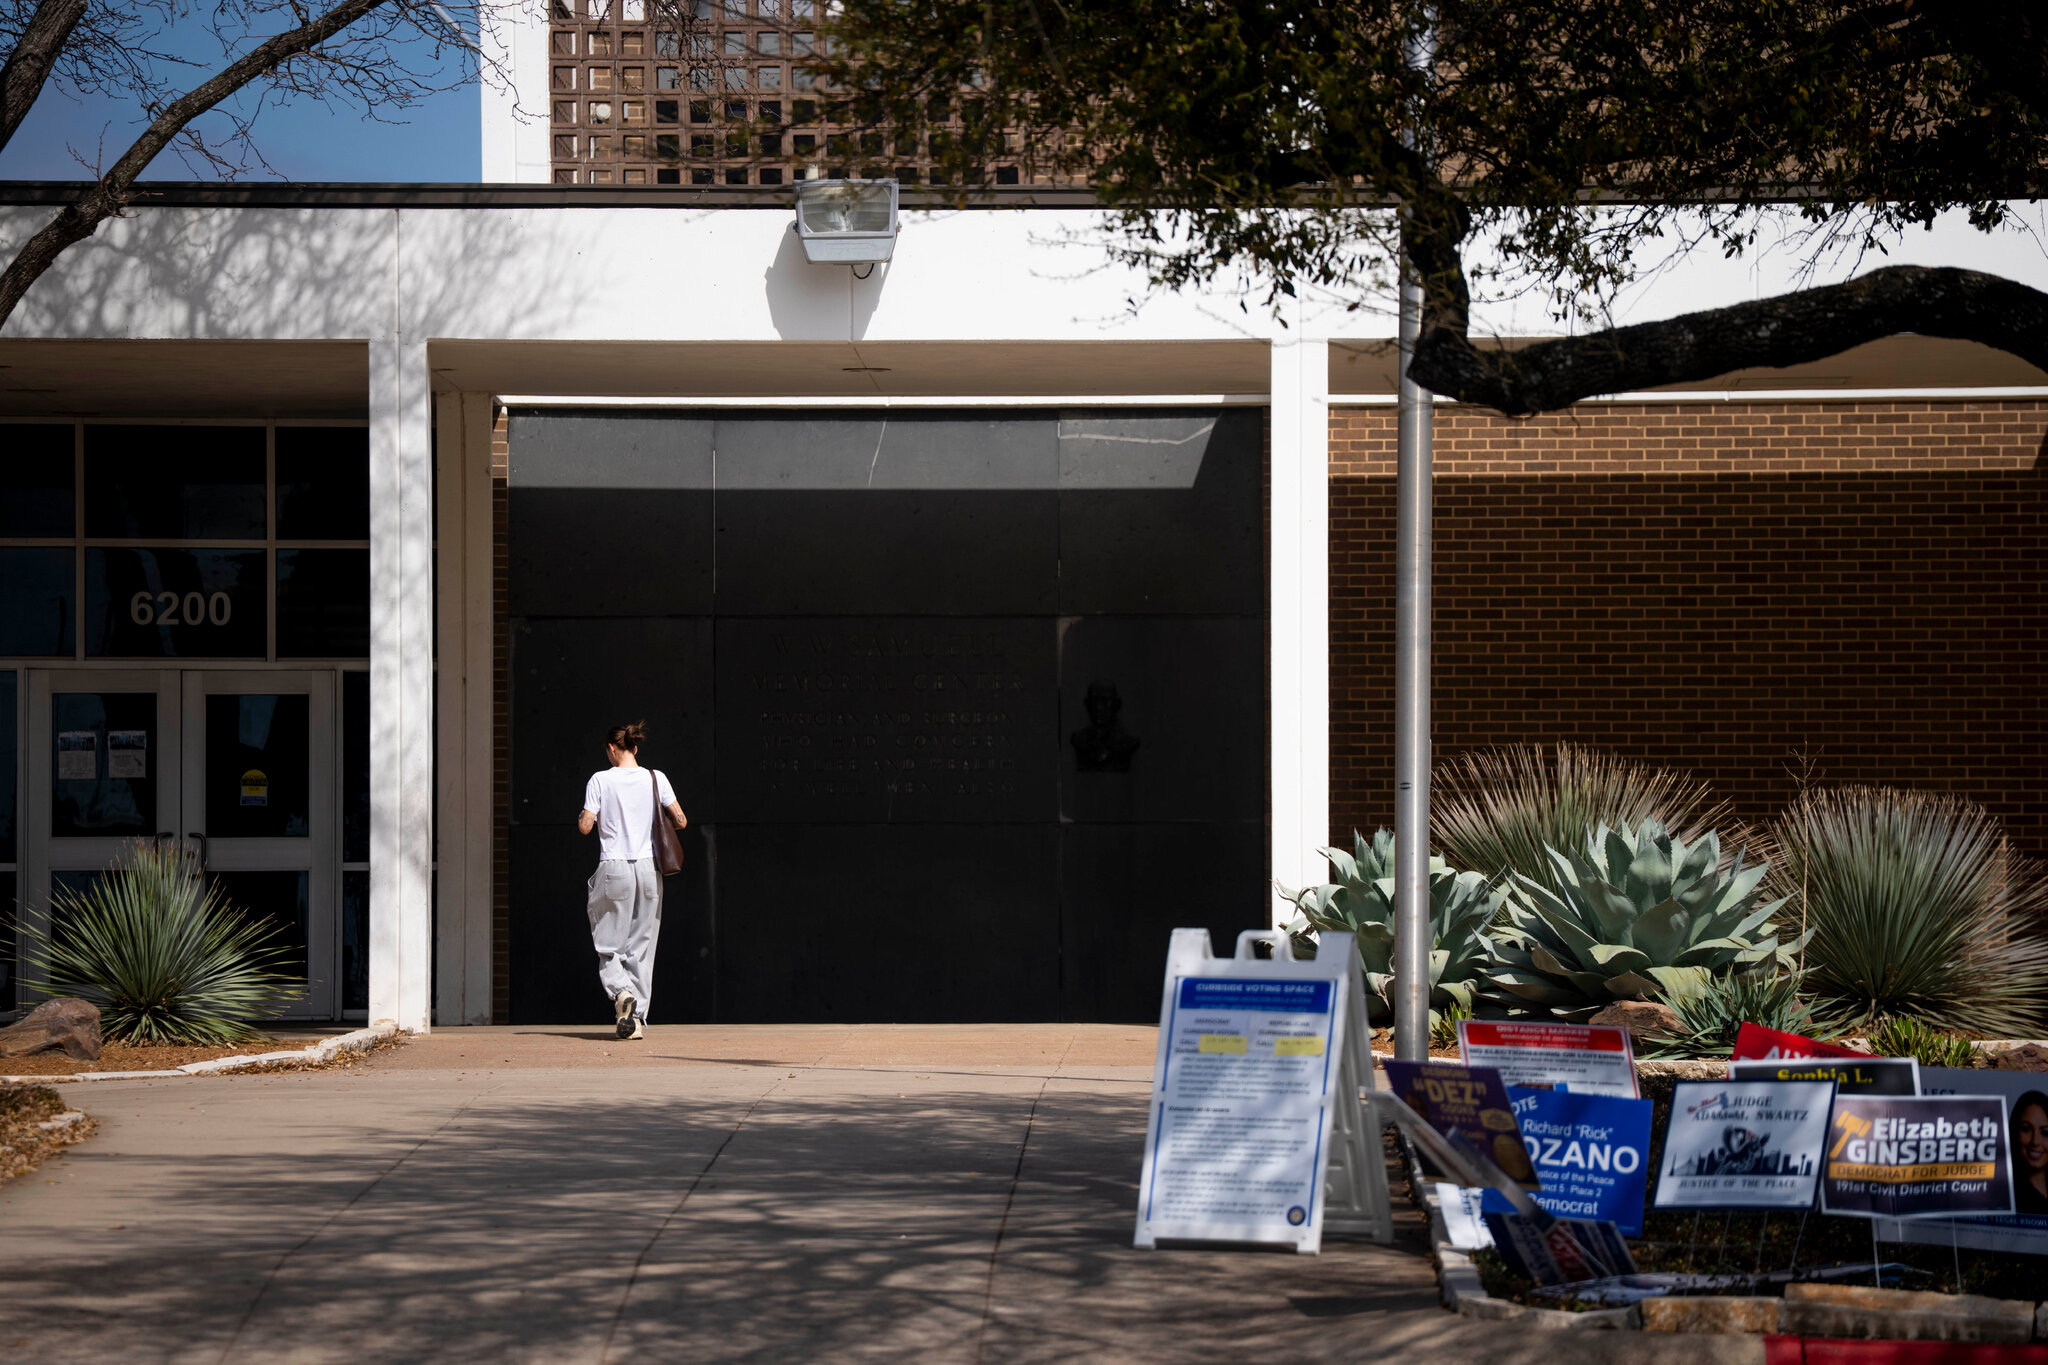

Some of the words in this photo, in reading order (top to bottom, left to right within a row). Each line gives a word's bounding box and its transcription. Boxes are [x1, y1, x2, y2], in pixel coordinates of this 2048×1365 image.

[130, 590, 232, 626] 6200
[848, 633, 1006, 657] SAMUELL
[751, 671, 897, 692] MEMORIAL
[911, 671, 1026, 692] CENTER
[760, 711, 859, 726] PHYSICIAN
[872, 711, 912, 726] AND
[923, 711, 1015, 726] SURGEON
[760, 734, 811, 749] WHO
[831, 734, 877, 749] HAD
[896, 734, 1015, 749] CONCERN
[760, 757, 801, 771] FOR
[872, 757, 916, 771] AND
[1195, 982, 1243, 992] CURBSIDE
[1245, 983, 1282, 993] VOTING
[1283, 984, 1315, 993] SPACE
[1496, 1025, 1546, 1036] DISTANCE
[1549, 1027, 1590, 1036] MARKER
[1511, 1096, 1538, 1117] OTE
[1733, 1095, 1774, 1108] JUDGE
[1755, 1110, 1809, 1121] SWARTZ
[1523, 1118, 1572, 1137] Richard
[1873, 1116, 1998, 1140] Elizabeth
[1523, 1135, 1640, 1175] OZANO
[1846, 1137, 1997, 1166] GINSBERG
[1536, 1169, 1559, 1180] ustice
[1560, 1170, 1571, 1181] of
[1571, 1171, 1586, 1182] the
[1587, 1173, 1615, 1186] Peace
[1836, 1165, 1909, 1179] DEMOCRAT
[1912, 1166, 1938, 1178] FOR
[1942, 1164, 1987, 1177] JUDGE
[1570, 1184, 1594, 1196] Place
[1679, 1178, 1718, 1189] JUSTICE
[1723, 1178, 1736, 1188] OF
[1741, 1178, 1759, 1188] THE
[1764, 1178, 1797, 1188] PLACE
[1836, 1180, 1866, 1194] 191st
[1869, 1182, 1897, 1196] Civil
[1899, 1181, 1948, 1196] District
[1951, 1180, 1988, 1193] Court
